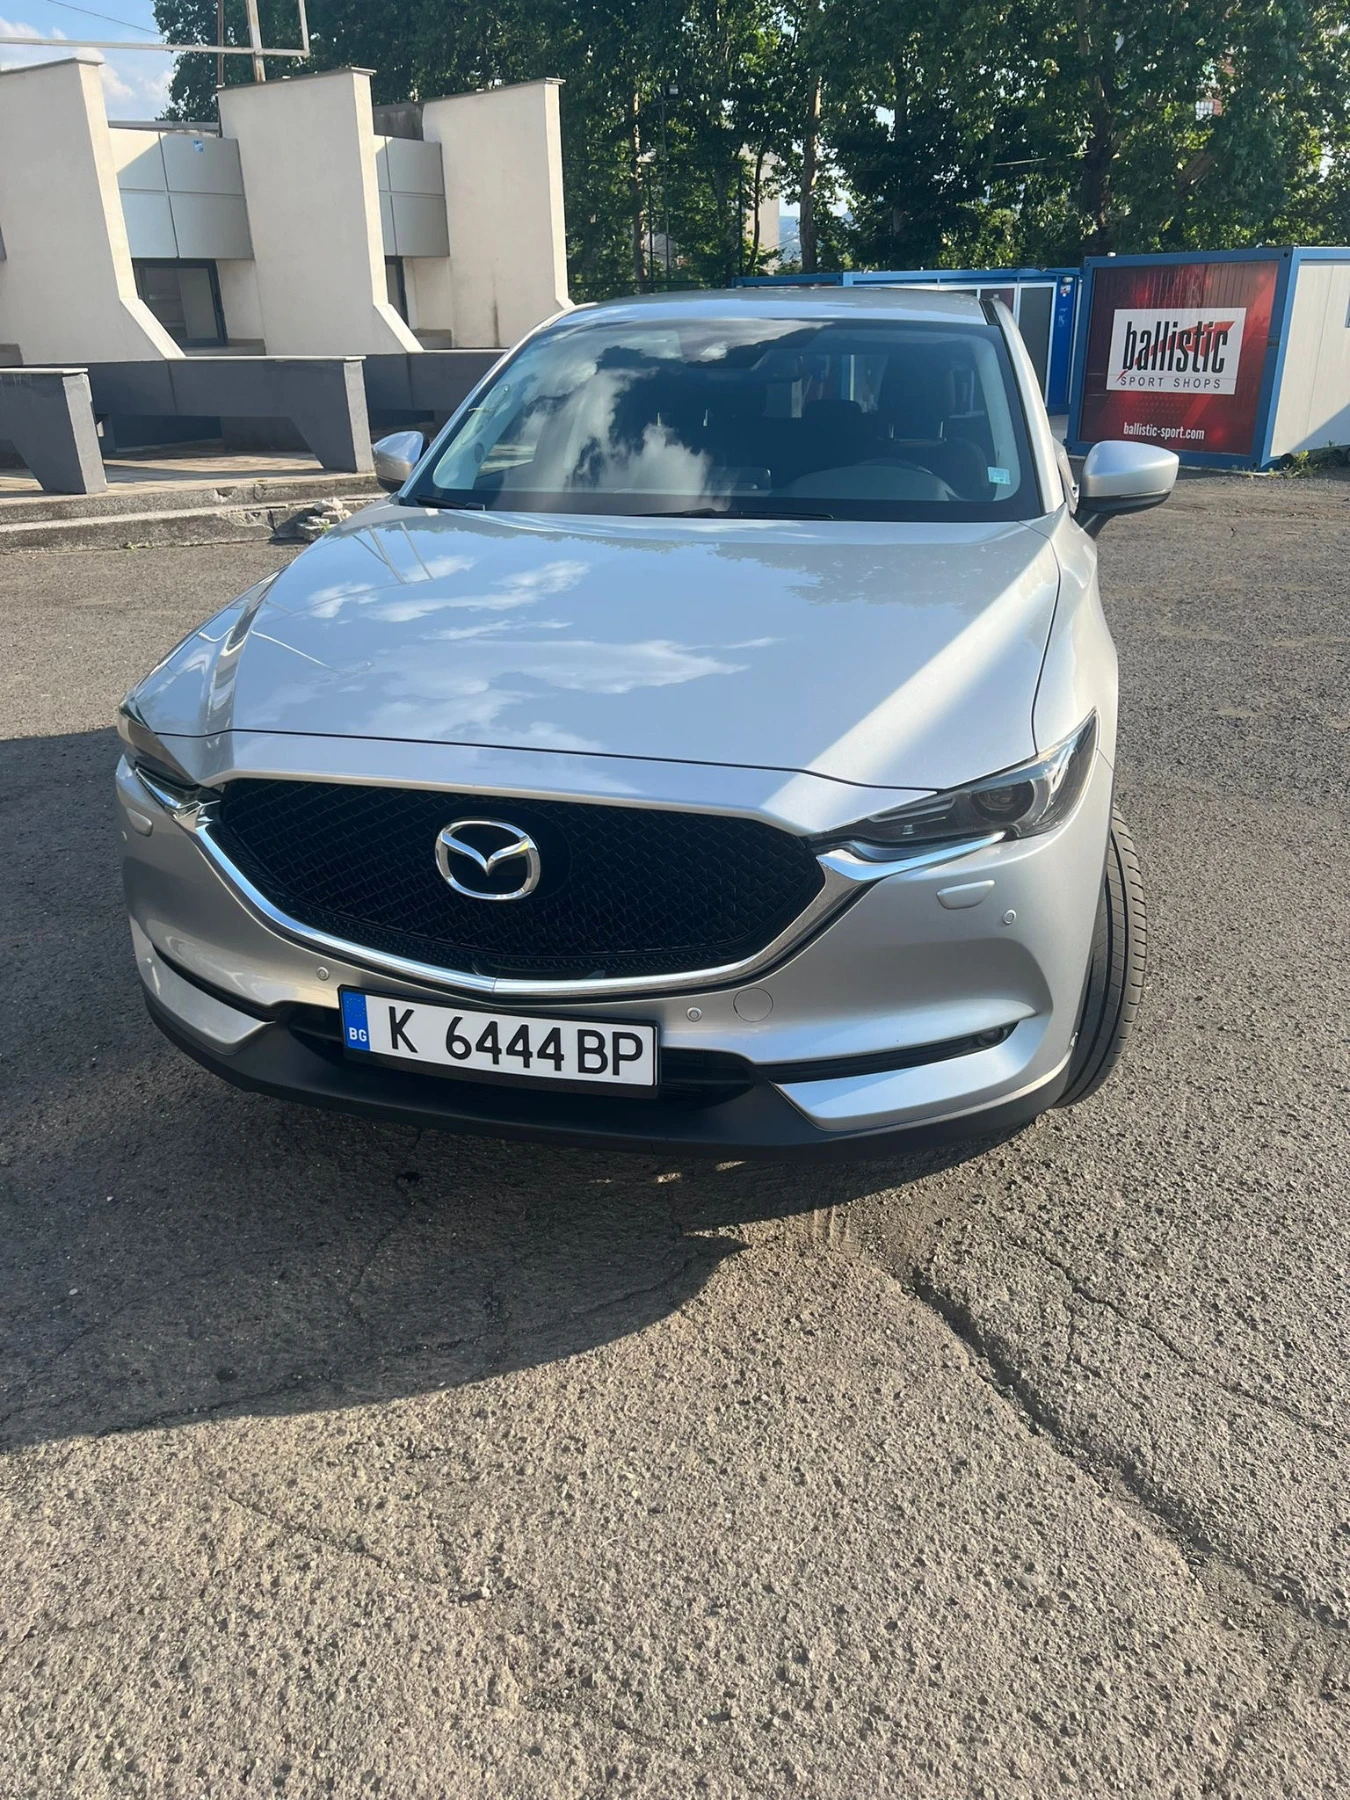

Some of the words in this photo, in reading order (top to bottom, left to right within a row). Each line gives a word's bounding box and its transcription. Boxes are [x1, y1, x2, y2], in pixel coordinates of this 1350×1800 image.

[1122, 320, 1229, 373] ballistic
[1120, 376, 1164, 387] SPORT
[1173, 377, 1221, 389] SHOPS
[1123, 422, 1205, 440] ballistic-sport.com
[349, 1027, 367, 1042] BG
[388, 1005, 418, 1054] K
